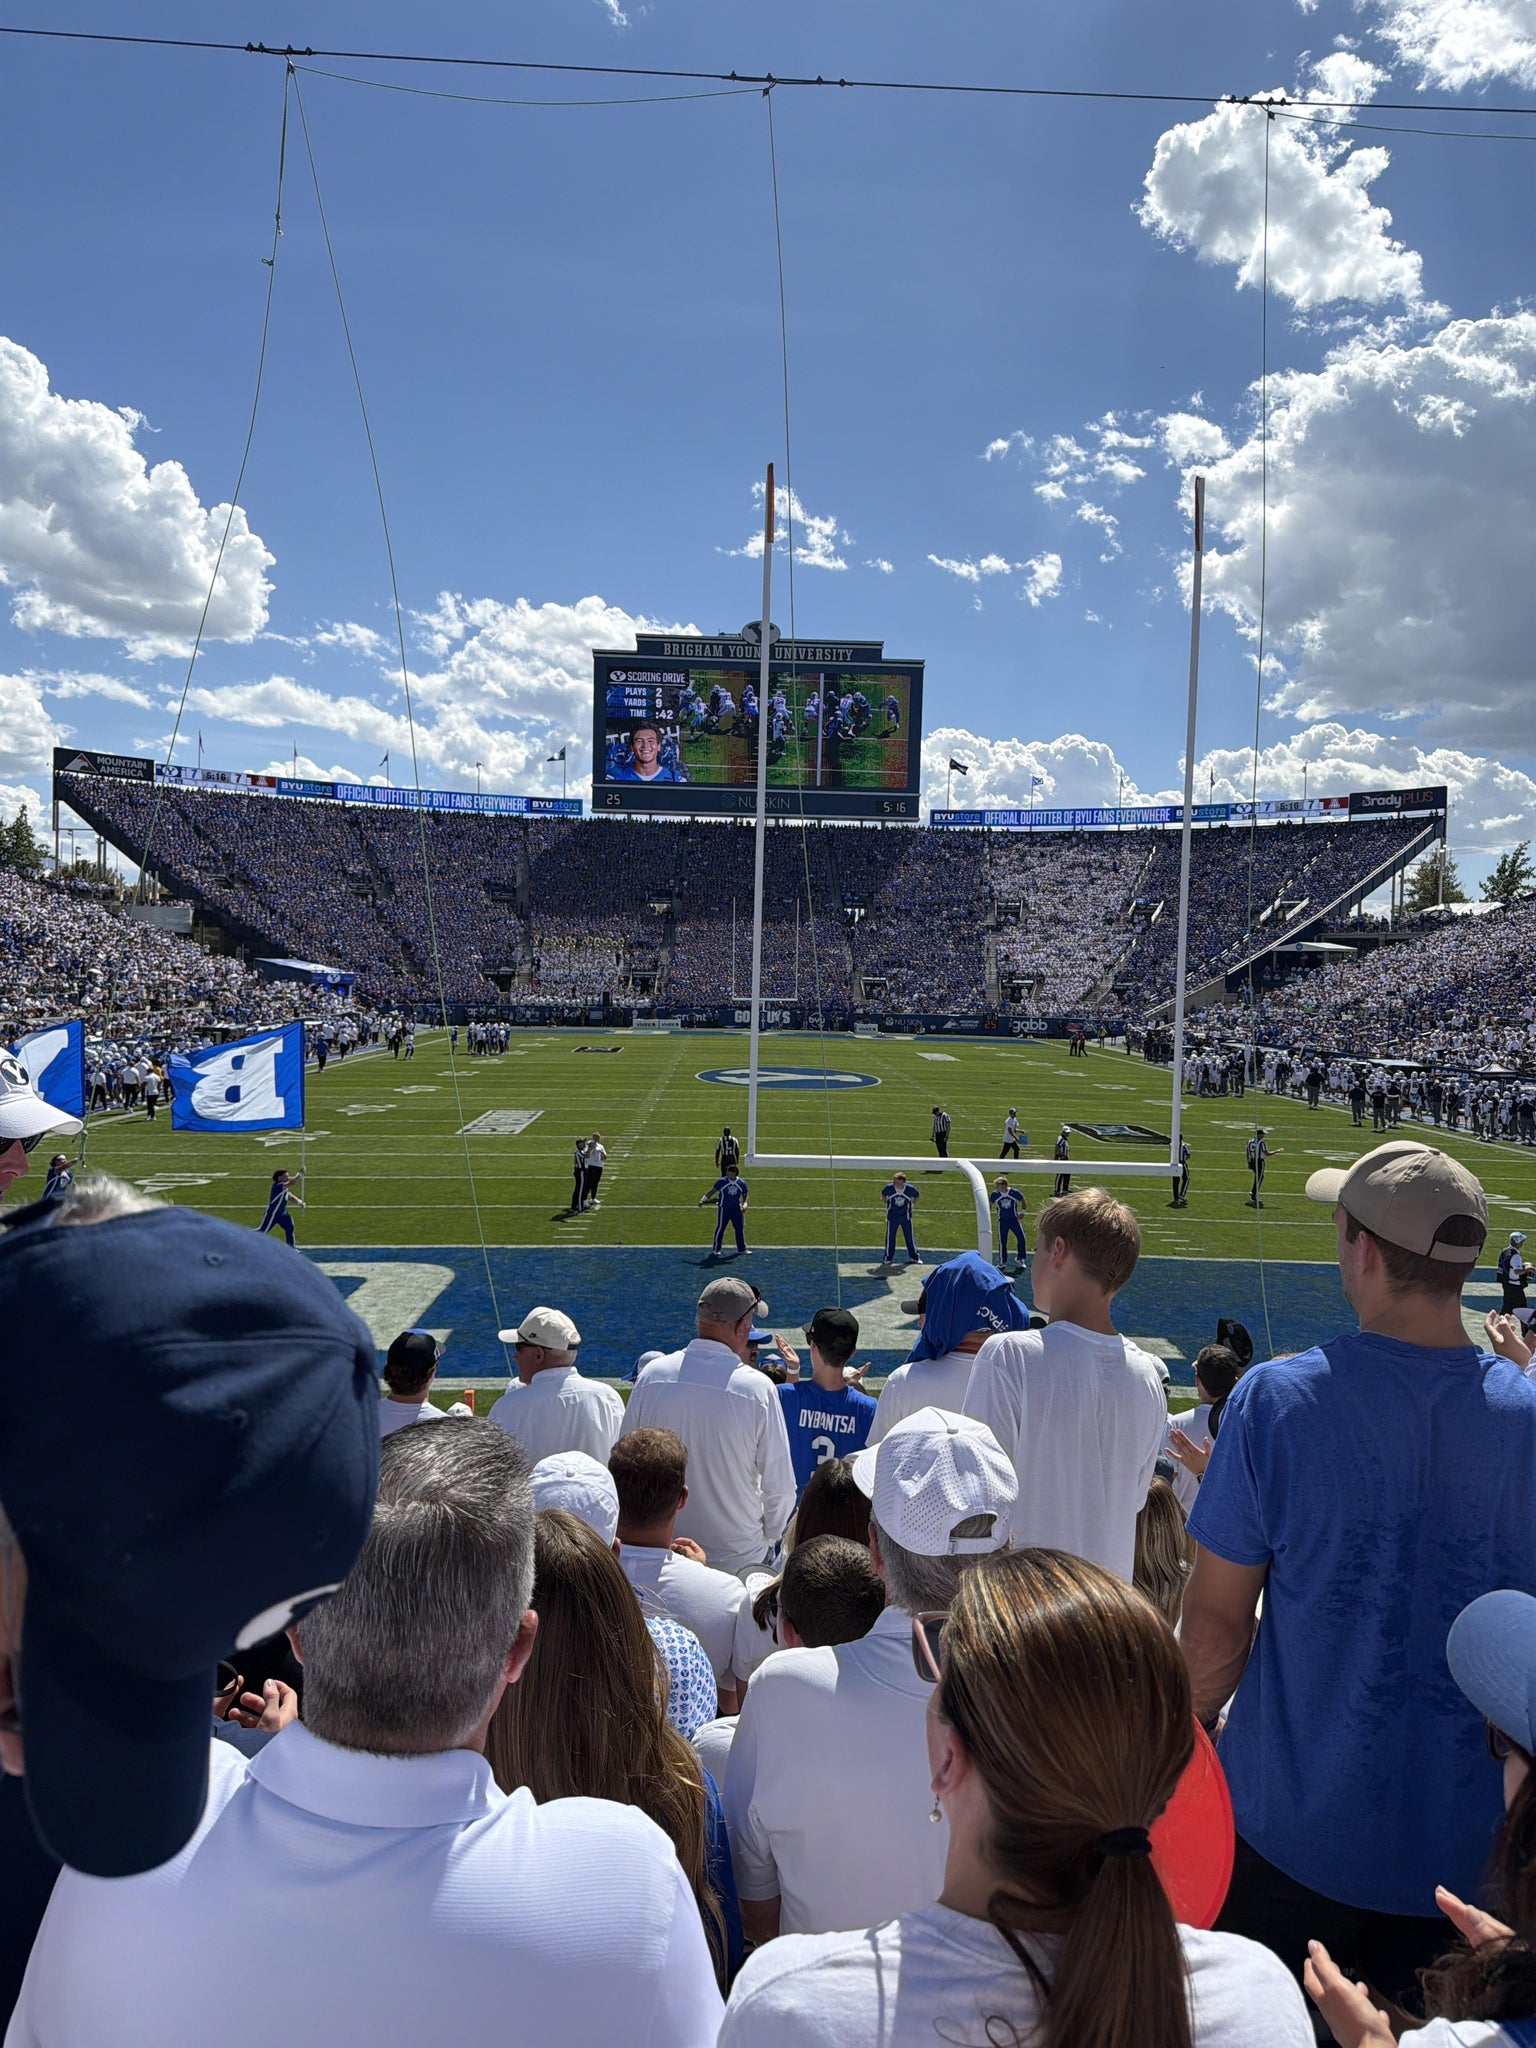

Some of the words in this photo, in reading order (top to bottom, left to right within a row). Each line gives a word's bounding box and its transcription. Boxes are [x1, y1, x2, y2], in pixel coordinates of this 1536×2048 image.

[663, 643, 723, 657] BRIGHAM
[729, 645, 770, 659] YOUN
[775, 647, 853, 661] UNIVERSITY
[627, 671, 661, 682] SCORING
[662, 672, 686, 683] DRIVE
[625, 687, 647, 696] PLAYS
[655, 687, 663, 698] 2
[623, 697, 647, 707] YARDS
[655, 698, 663, 708] 9
[630, 708, 647, 718] TIME
[655, 709, 674, 720] :42
[97, 756, 147, 770] MOUNTAIN
[100, 765, 144, 778] AMERICA
[337, 785, 374, 801] OFFICIAL
[375, 788, 419, 805] OUTFITTER
[421, 791, 430, 806] OF
[433, 792, 450, 807] BYU
[451, 793, 473, 809] FANS
[474, 794, 527, 812] EVERYWHERE
[606, 793, 621, 805] 25
[883, 802, 907, 814] 5:16
[1176, 806, 1226, 817] BUstore
[985, 811, 1018, 825] OFFICIAL
[1020, 810, 1062, 825] OUTFITTER
[1064, 810, 1074, 824] OF
[1075, 809, 1092, 824] BYU
[1093, 808, 1114, 823] FANS
[1116, 807, 1171, 822] EVERYWHERE
[734, 1010, 750, 1023] GO
[799, 1409, 856, 1434] DYBANTSA
